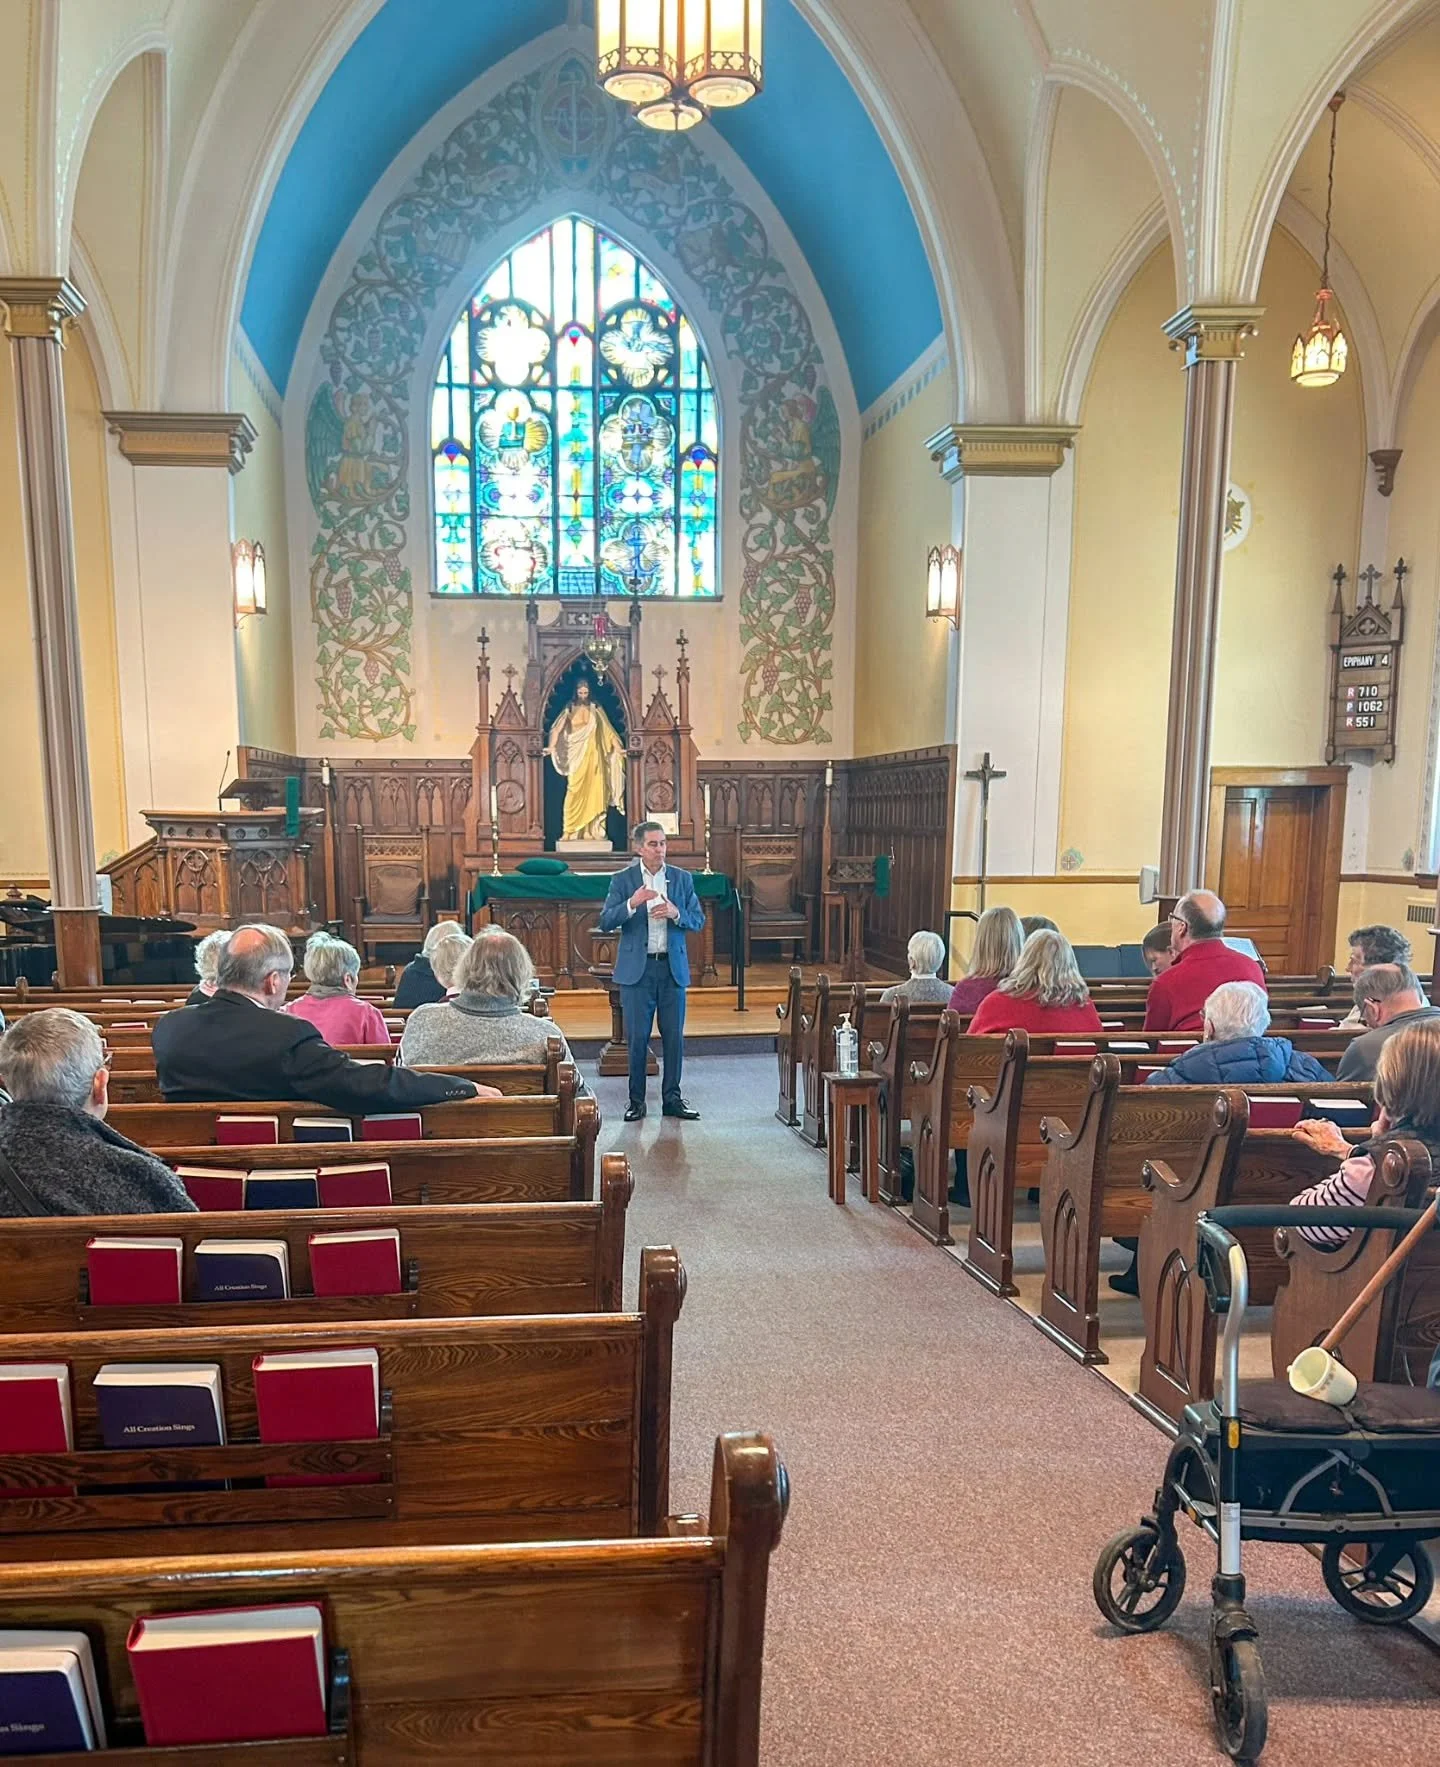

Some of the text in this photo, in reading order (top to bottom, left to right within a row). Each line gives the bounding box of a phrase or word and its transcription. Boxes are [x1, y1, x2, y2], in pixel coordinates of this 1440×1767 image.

[1343, 654, 1388, 667] EPIPHANY 4
[1347, 686, 1378, 697] R 710
[1346, 700, 1383, 712] P 1062
[1346, 716, 1374, 728] R 551
[123, 1423, 195, 1433] All Creation Sings
